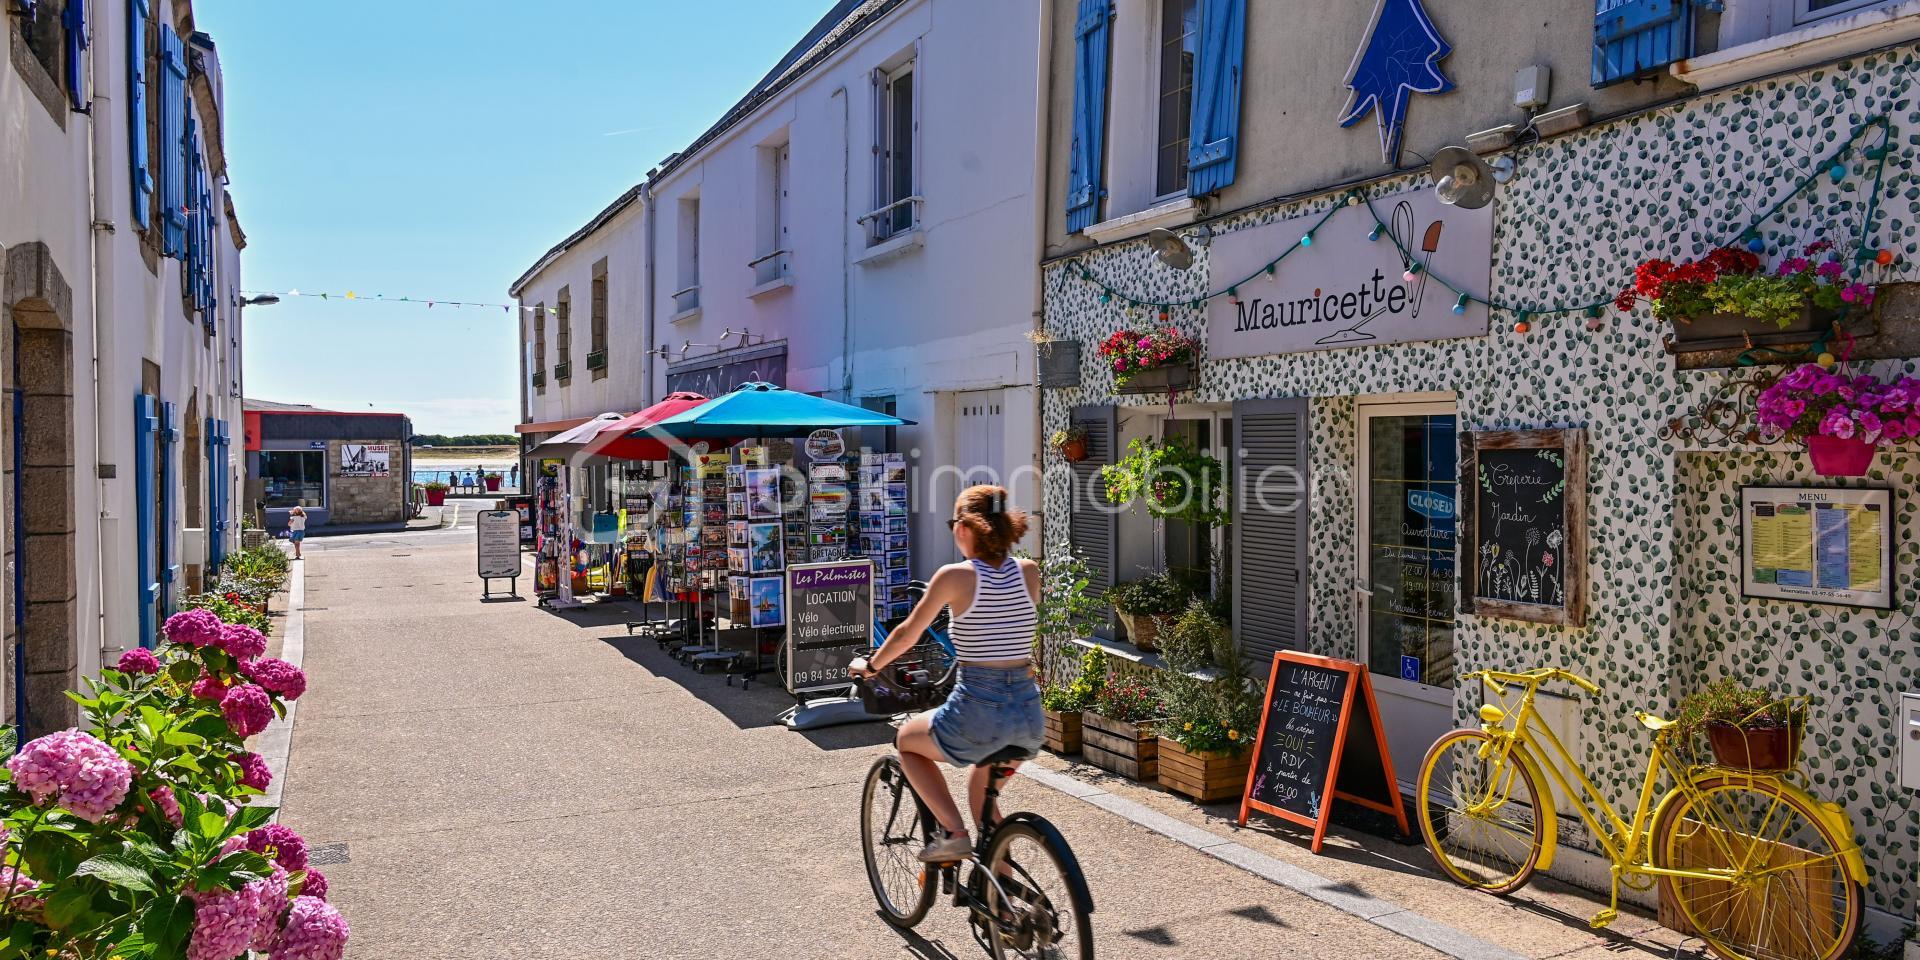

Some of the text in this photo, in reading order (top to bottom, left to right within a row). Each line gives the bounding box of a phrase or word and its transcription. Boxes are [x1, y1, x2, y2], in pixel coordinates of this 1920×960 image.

[1234, 268, 1406, 332] Mauricette
[1410, 493, 1453, 513] CLOSED
[1799, 493, 1827, 501] MENU
[1491, 501, 1537, 537] Jardin
[1401, 521, 1453, 540] Ouverture
[812, 547, 845, 560] BRETAGNE
[796, 569, 867, 585] Les Palmistes
[806, 590, 856, 605] LOCATION
[798, 611, 819, 624] Vélo
[798, 622, 865, 638] Vélo électrique
[795, 671, 808, 684] 09
[810, 670, 823, 682] 84
[826, 668, 838, 680] 52
[1291, 668, 1340, 693] L'ARGENT
[1285, 734, 1304, 752] OUI
[1280, 751, 1306, 770] RDV
[1275, 769, 1298, 781] partir
[1301, 771, 1312, 785] de
[1272, 782, 1298, 799] 19:00
